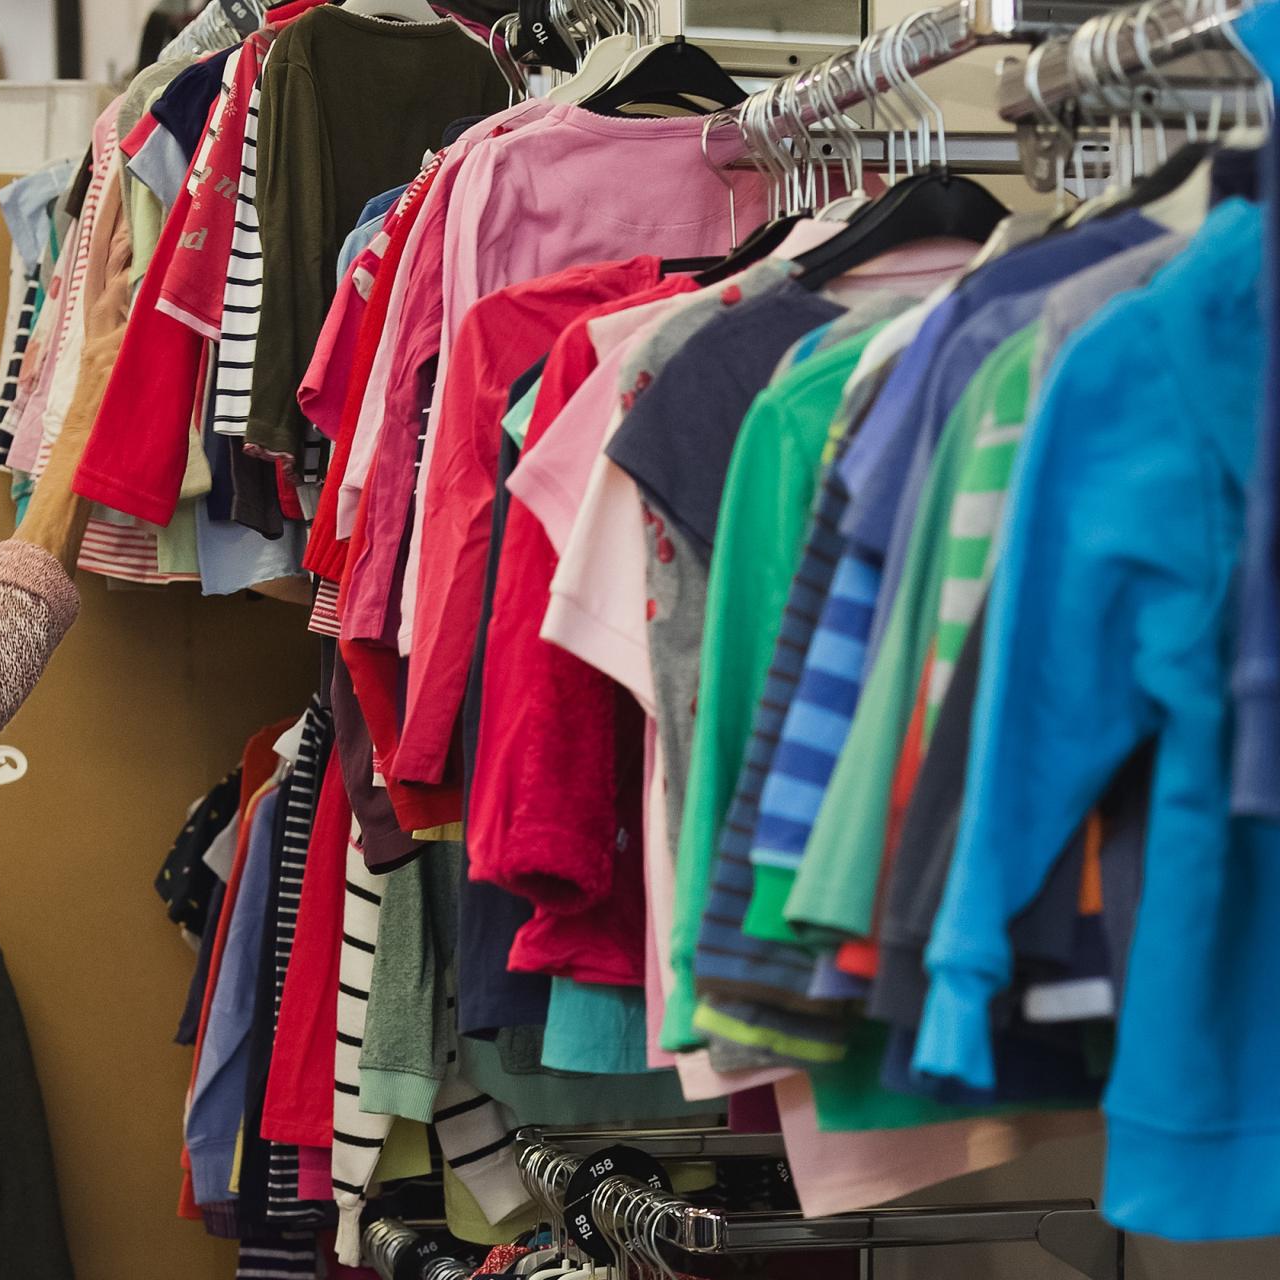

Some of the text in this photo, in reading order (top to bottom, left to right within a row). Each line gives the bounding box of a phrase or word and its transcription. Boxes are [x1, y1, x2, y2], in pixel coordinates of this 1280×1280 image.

[532, 22, 549, 45] 110
[589, 1158, 614, 1178] 158
[647, 1174, 662, 1191] 15
[575, 1214, 593, 1240] 158
[417, 1241, 438, 1257] 146
